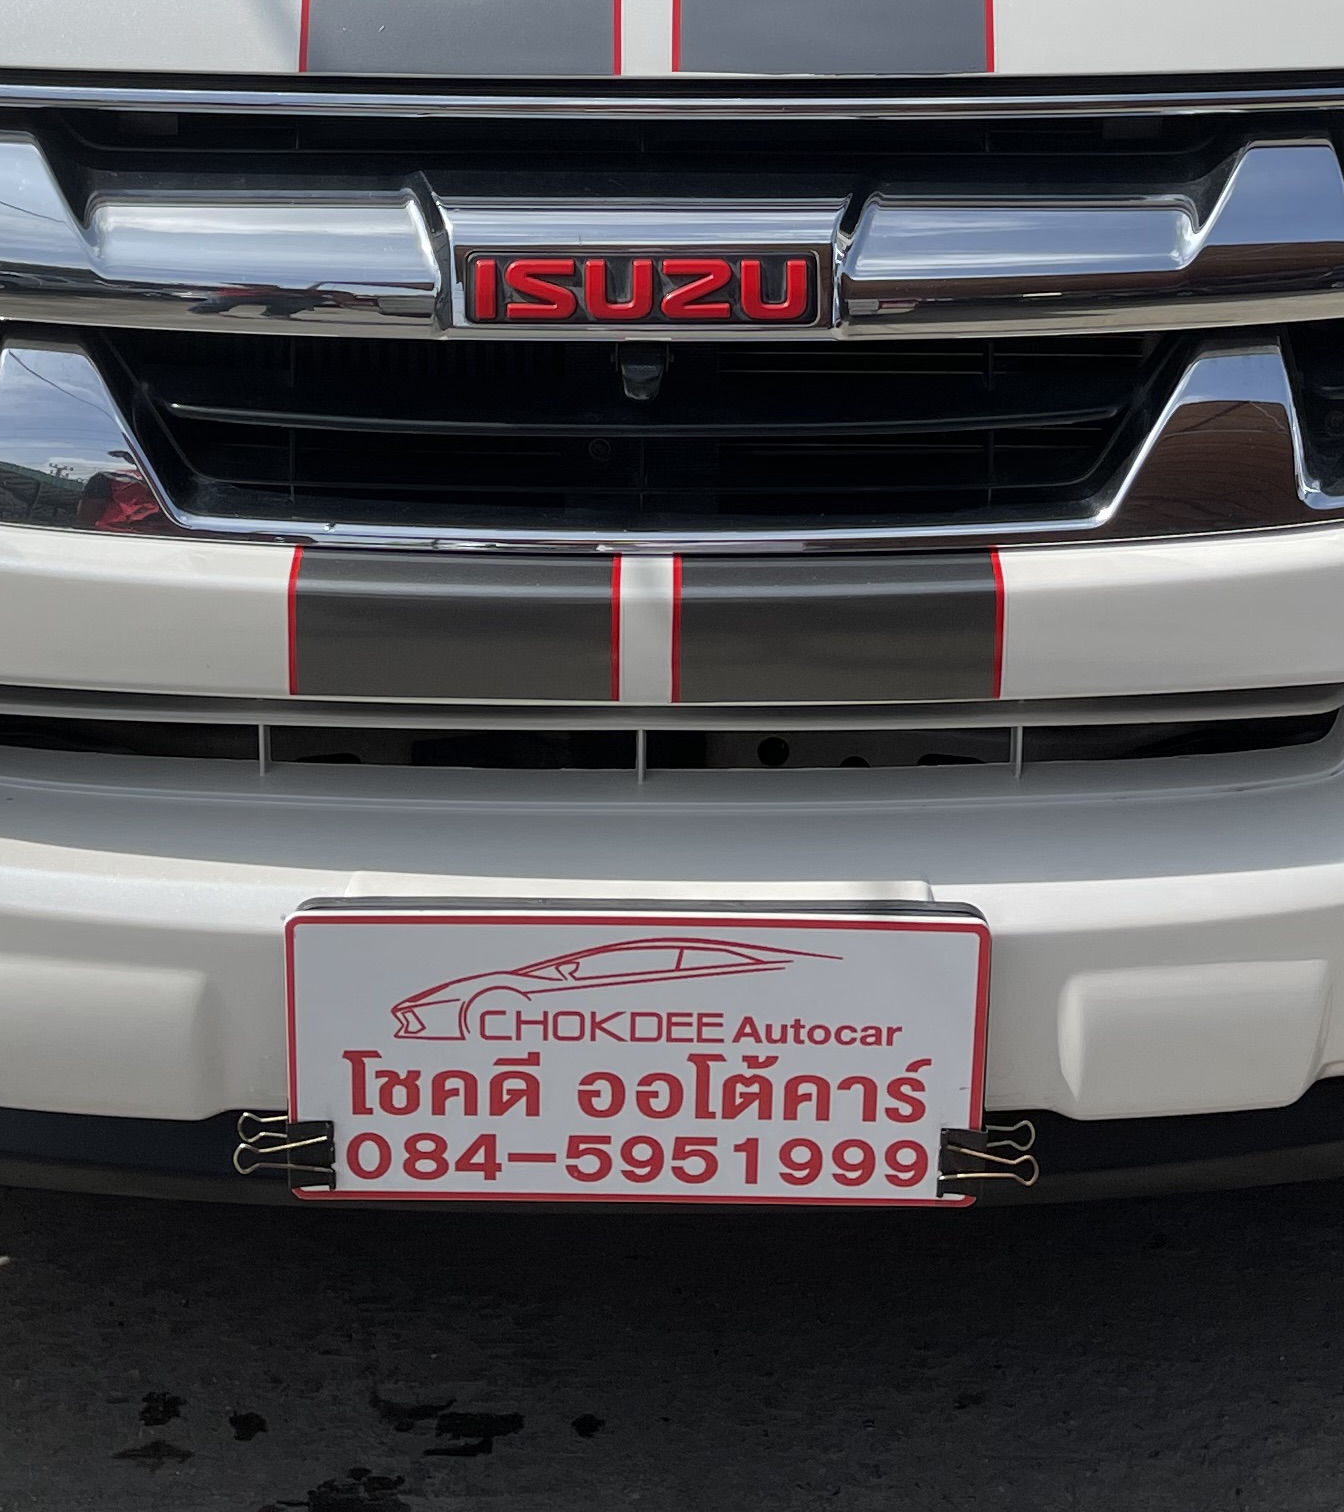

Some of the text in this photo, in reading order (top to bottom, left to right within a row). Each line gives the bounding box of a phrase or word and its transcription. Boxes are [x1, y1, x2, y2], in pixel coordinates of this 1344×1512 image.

[474, 258, 808, 320] ISUZU
[479, 1010, 903, 1047] CHOKDEE Autocar
[341, 1050, 933, 1124] โชคดี ออโต้คาร์
[346, 1131, 929, 1188] 084-5951999
